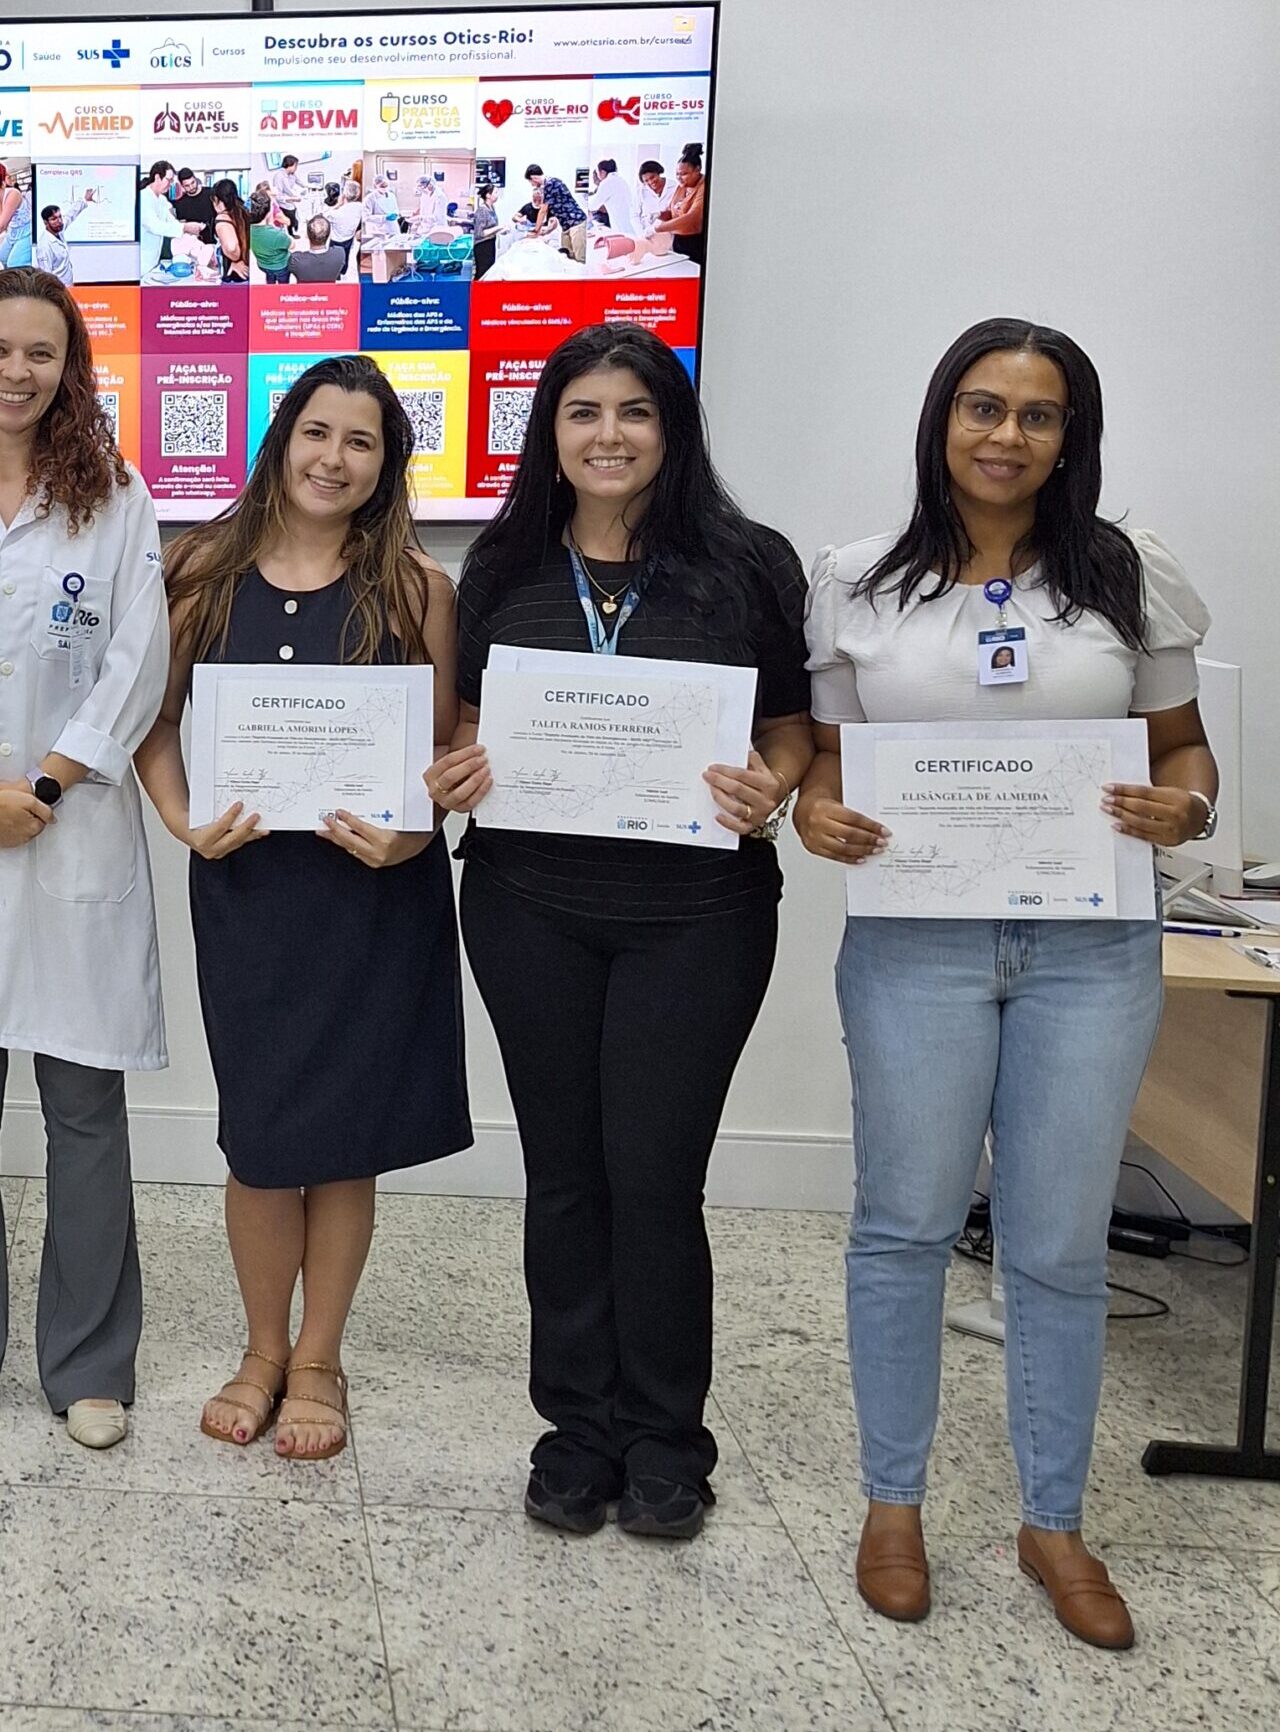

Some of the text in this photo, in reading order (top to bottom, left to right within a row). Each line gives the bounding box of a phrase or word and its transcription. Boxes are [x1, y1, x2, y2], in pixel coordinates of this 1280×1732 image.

[264, 28, 534, 49] Descubra os cursos Otics-Rio!
[33, 52, 61, 61] Saúde
[76, 49, 100, 60] SUS
[212, 48, 246, 56] Cursos
[150, 53, 192, 68] otics
[264, 50, 517, 66] Impulsione seu desenvolvimento profissional.
[282, 100, 323, 109] CURSO
[402, 94, 448, 105] CURSO
[525, 98, 555, 106] CURSO
[644, 99, 704, 110] URGE-SUS
[74, 105, 114, 115] CURSO
[184, 101, 223, 110] CURSO
[524, 104, 589, 115] SAVE-RIO
[184, 111, 225, 122] MANE
[281, 109, 358, 130] PBVM
[75, 115, 133, 131] IEMED
[184, 122, 239, 133] VA-SUS
[403, 117, 461, 129] VA-SUS
[170, 364, 217, 376] FAÇA SUA
[499, 360, 527, 371] FAÇA
[156, 373, 232, 386] PRÉ-INSCRIÇÃO
[485, 370, 541, 381] PRÉ-INSCR
[171, 464, 216, 475] Atenção!
[146, 552, 161, 561] SU
[252, 697, 345, 710] CERTIFICADO
[544, 690, 650, 707] CERTIFICADO
[238, 723, 358, 735] GABRIELA AMORIM LOPES
[530, 719, 661, 735] TALITA RAMOS FERREIRA
[914, 760, 1033, 773] CERTIFICADO
[902, 790, 1049, 801] ELISÂNGELA DE ALMEIDA
[627, 820, 648, 830] RIO
[1019, 895, 1043, 905] RIO
